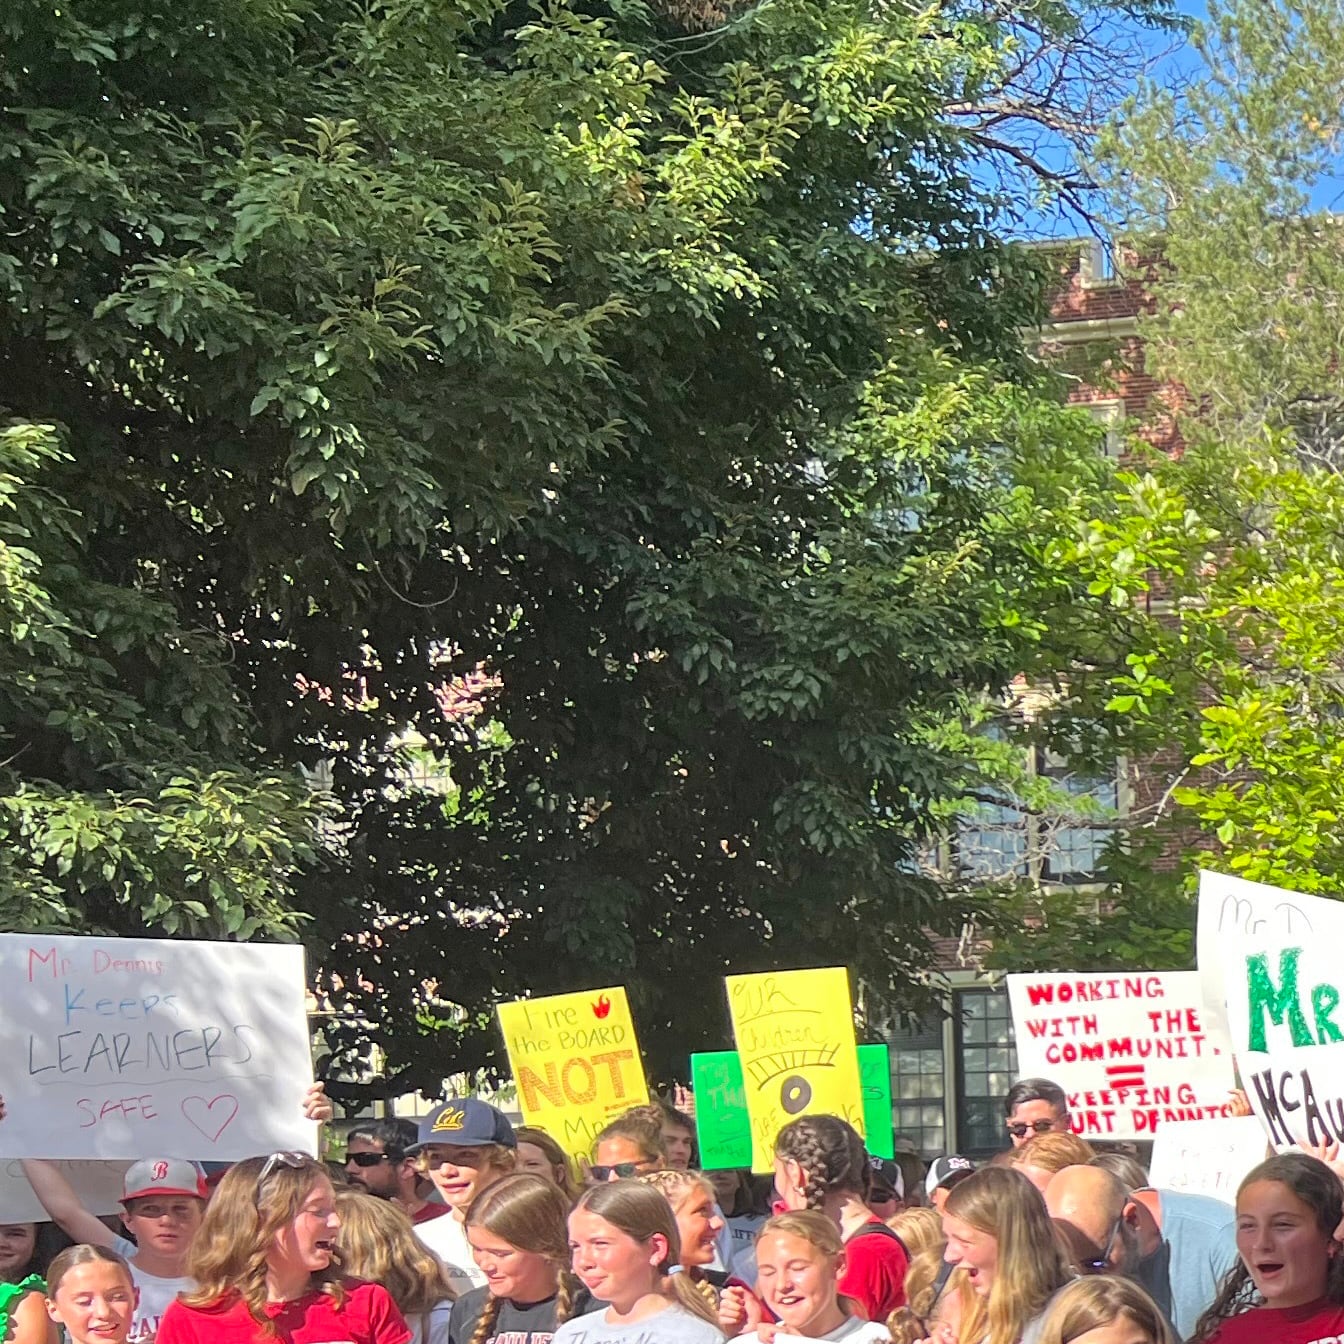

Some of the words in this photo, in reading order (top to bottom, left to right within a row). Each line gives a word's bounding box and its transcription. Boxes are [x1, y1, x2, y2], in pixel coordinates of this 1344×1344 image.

[93, 949, 167, 977] Dennis
[1025, 976, 1165, 1007] WORKING
[523, 1004, 577, 1031] Fire
[1024, 1014, 1099, 1038] WITH
[1148, 1007, 1202, 1033] THE
[29, 1024, 255, 1076] LEARNERS
[513, 1036, 552, 1055] the
[558, 1024, 626, 1051] BOARD
[1045, 1034, 1222, 1065] COMMUNIT
[517, 1049, 634, 1114] NOT
[1066, 1083, 1198, 1108] KEEPING
[76, 1094, 158, 1129] SAFE
[1069, 1110, 1115, 1135] URT
[151, 1160, 169, 1182] B
